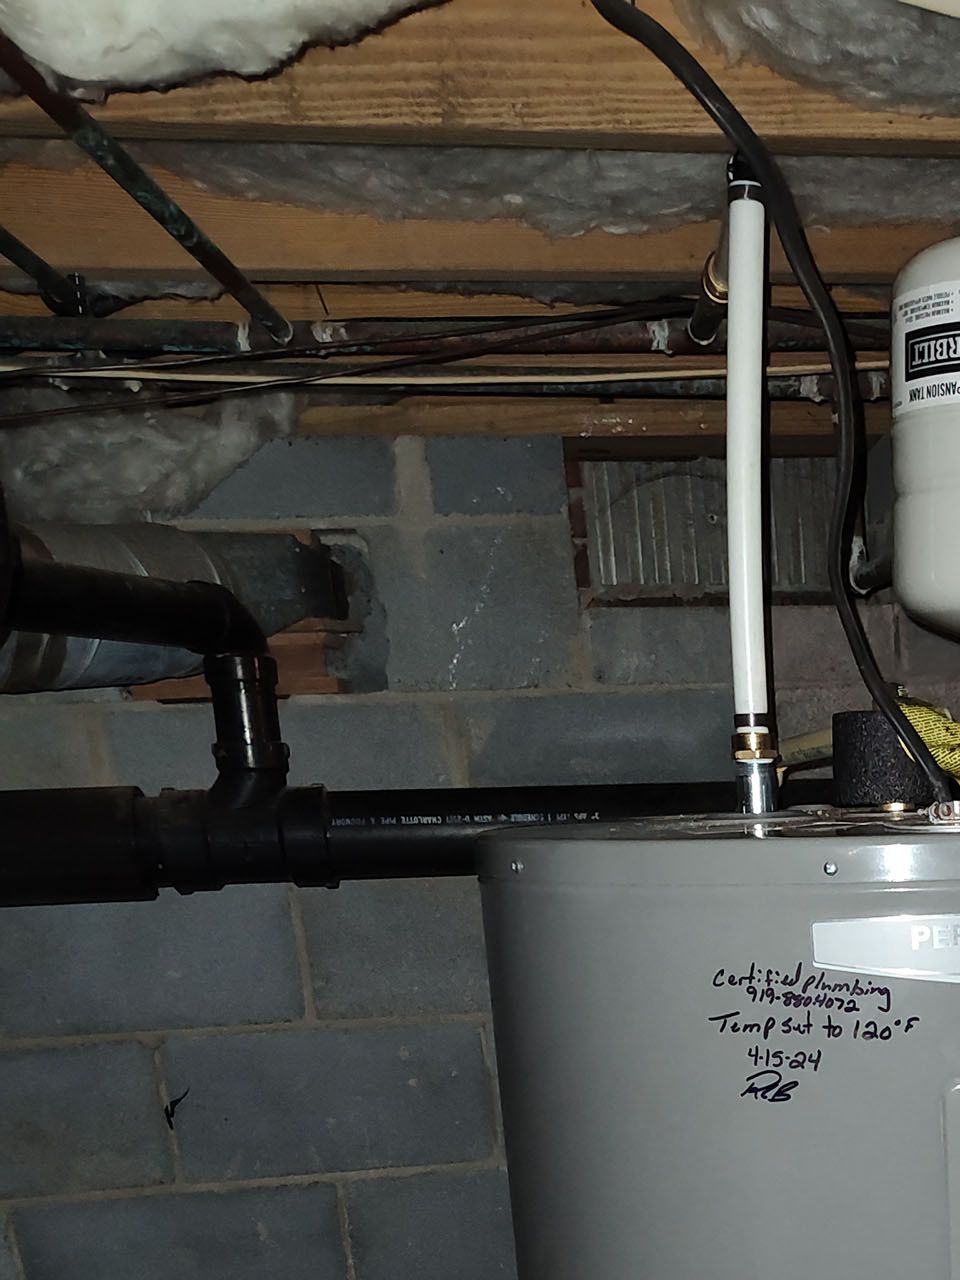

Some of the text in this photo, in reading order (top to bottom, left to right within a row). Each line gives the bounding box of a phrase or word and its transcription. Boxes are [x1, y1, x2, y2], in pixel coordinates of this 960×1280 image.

[908, 389, 925, 402] TANK
[400, 816, 442, 825] CHARLOTTE
[709, 1012, 775, 1040] Temp
[822, 1015, 843, 1039] to
